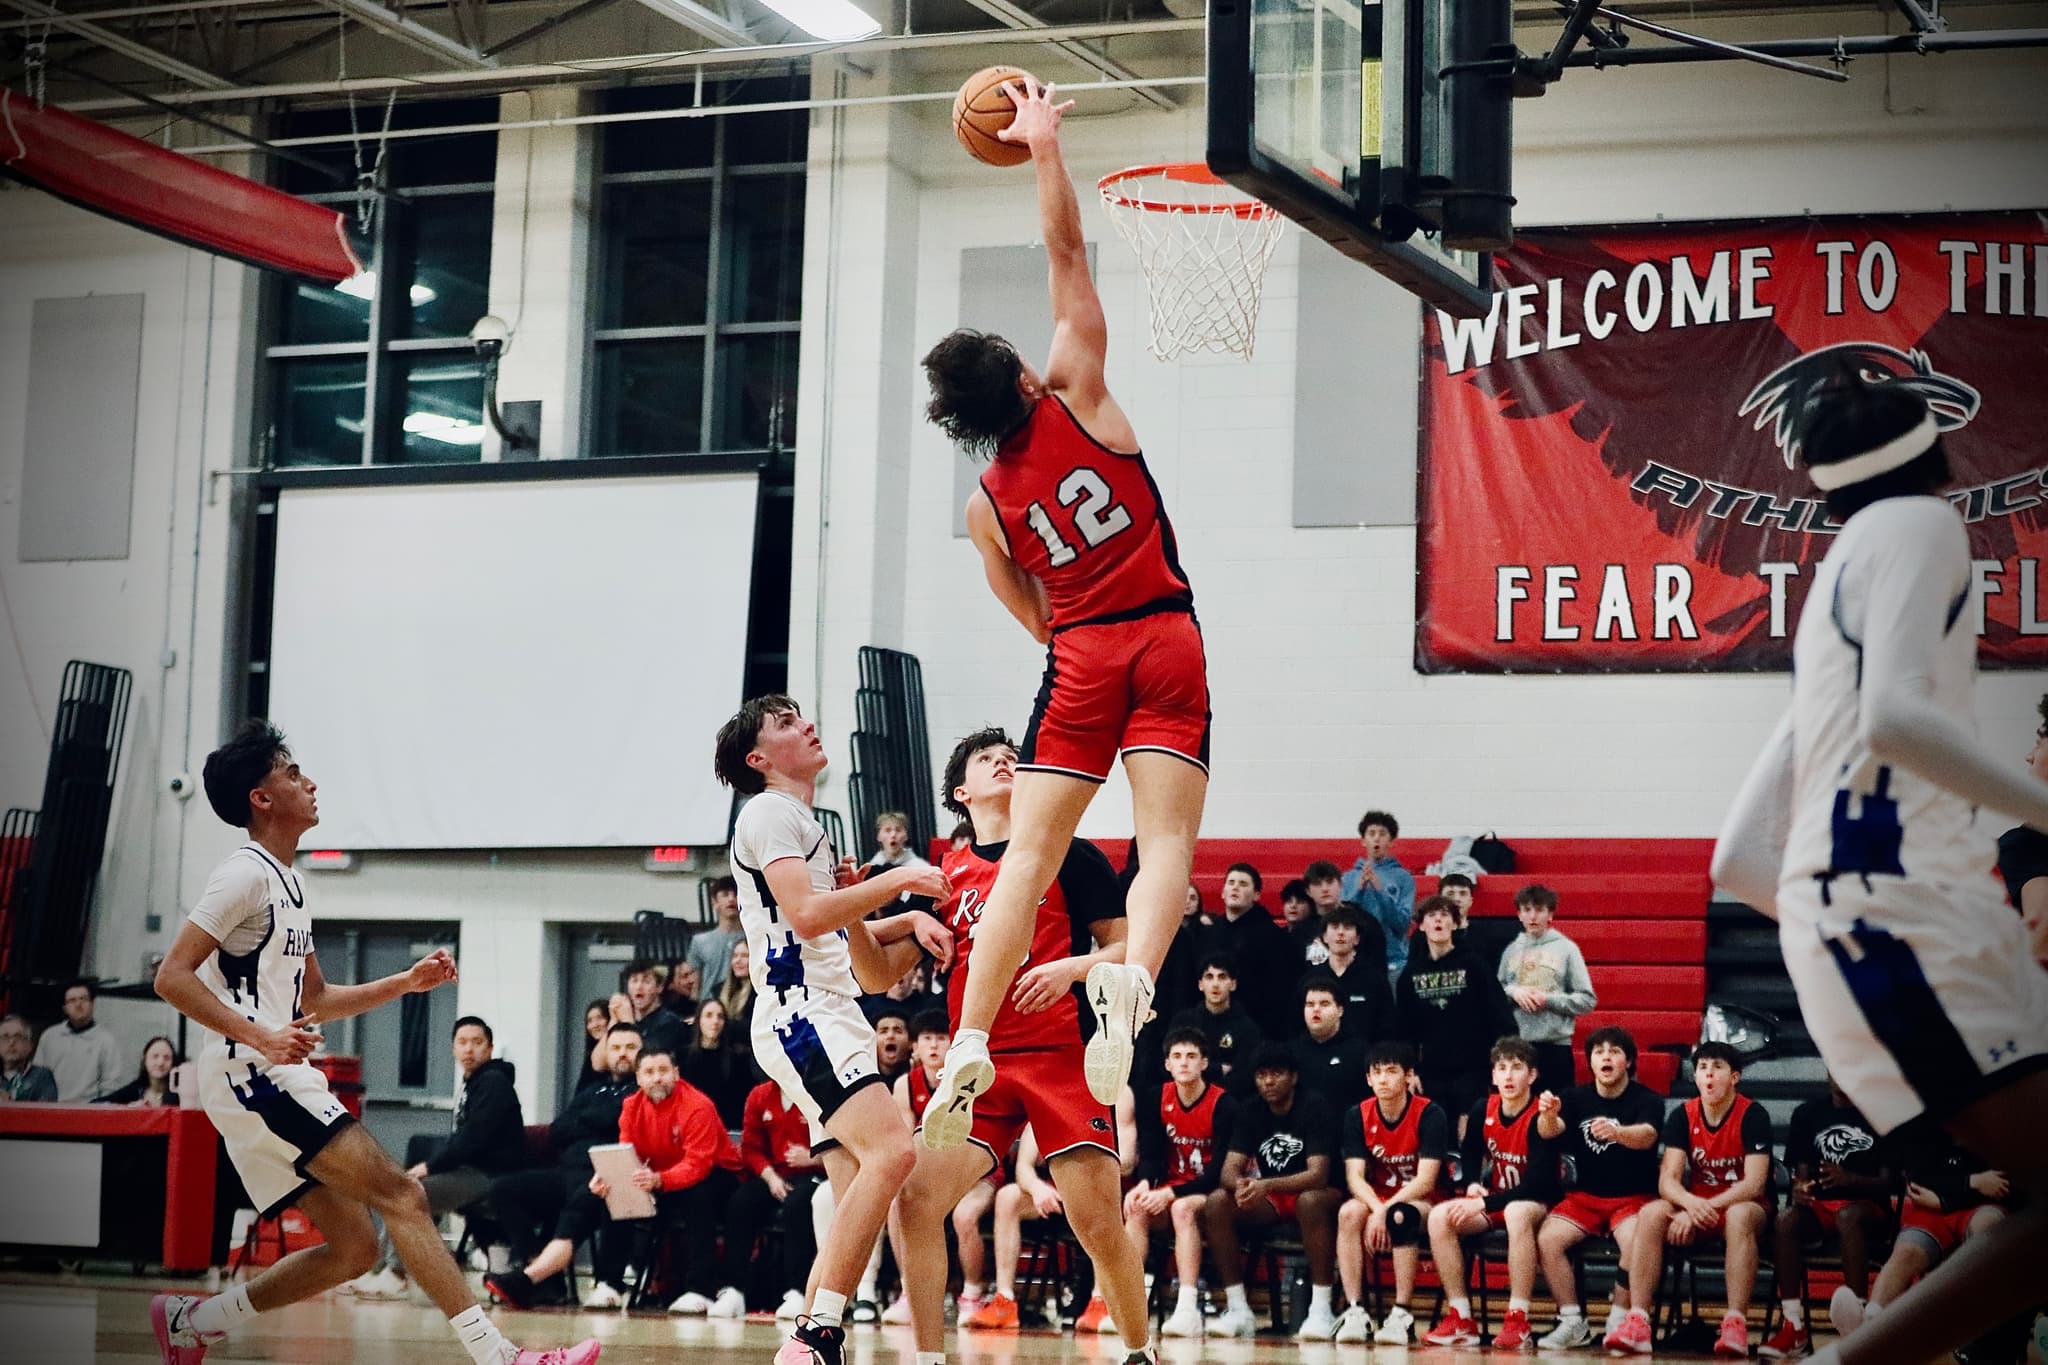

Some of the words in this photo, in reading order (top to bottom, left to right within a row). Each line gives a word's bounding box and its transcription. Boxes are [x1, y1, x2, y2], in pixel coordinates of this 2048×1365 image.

[1436, 247, 1774, 374] WELCOME
[1815, 240, 1899, 313] TO
[1027, 467, 1133, 568] 12
[1496, 563, 1699, 640] FEAR
